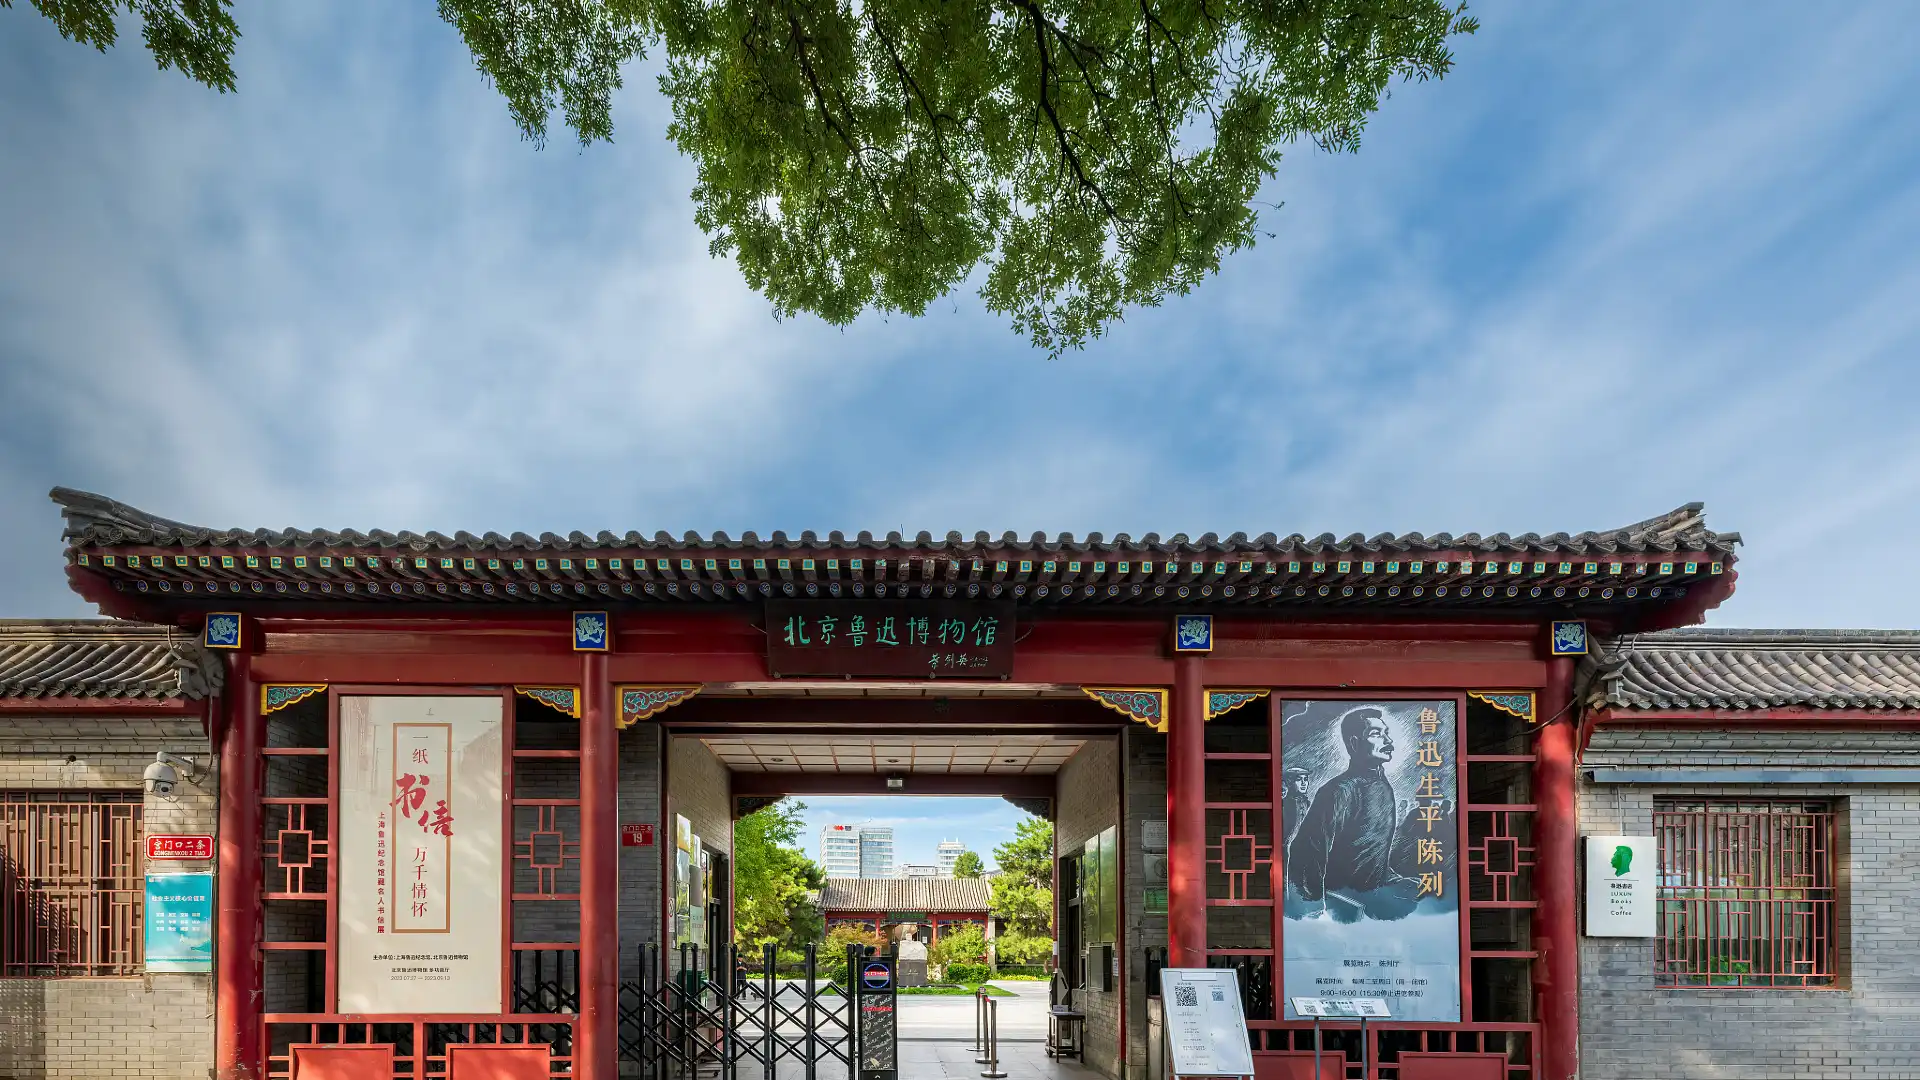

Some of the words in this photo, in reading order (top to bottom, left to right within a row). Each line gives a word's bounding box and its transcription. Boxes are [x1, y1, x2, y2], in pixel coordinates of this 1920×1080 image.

[783, 615, 999, 647] 北京鲁迅博物馆
[632, 832, 643, 844] 19
[1415, 706, 1444, 898] 鲁迅生平陈列
[377, 811, 385, 934] 上海鲁迅纪念馆藏名人书信展
[411, 846, 429, 918] 万千情怀
